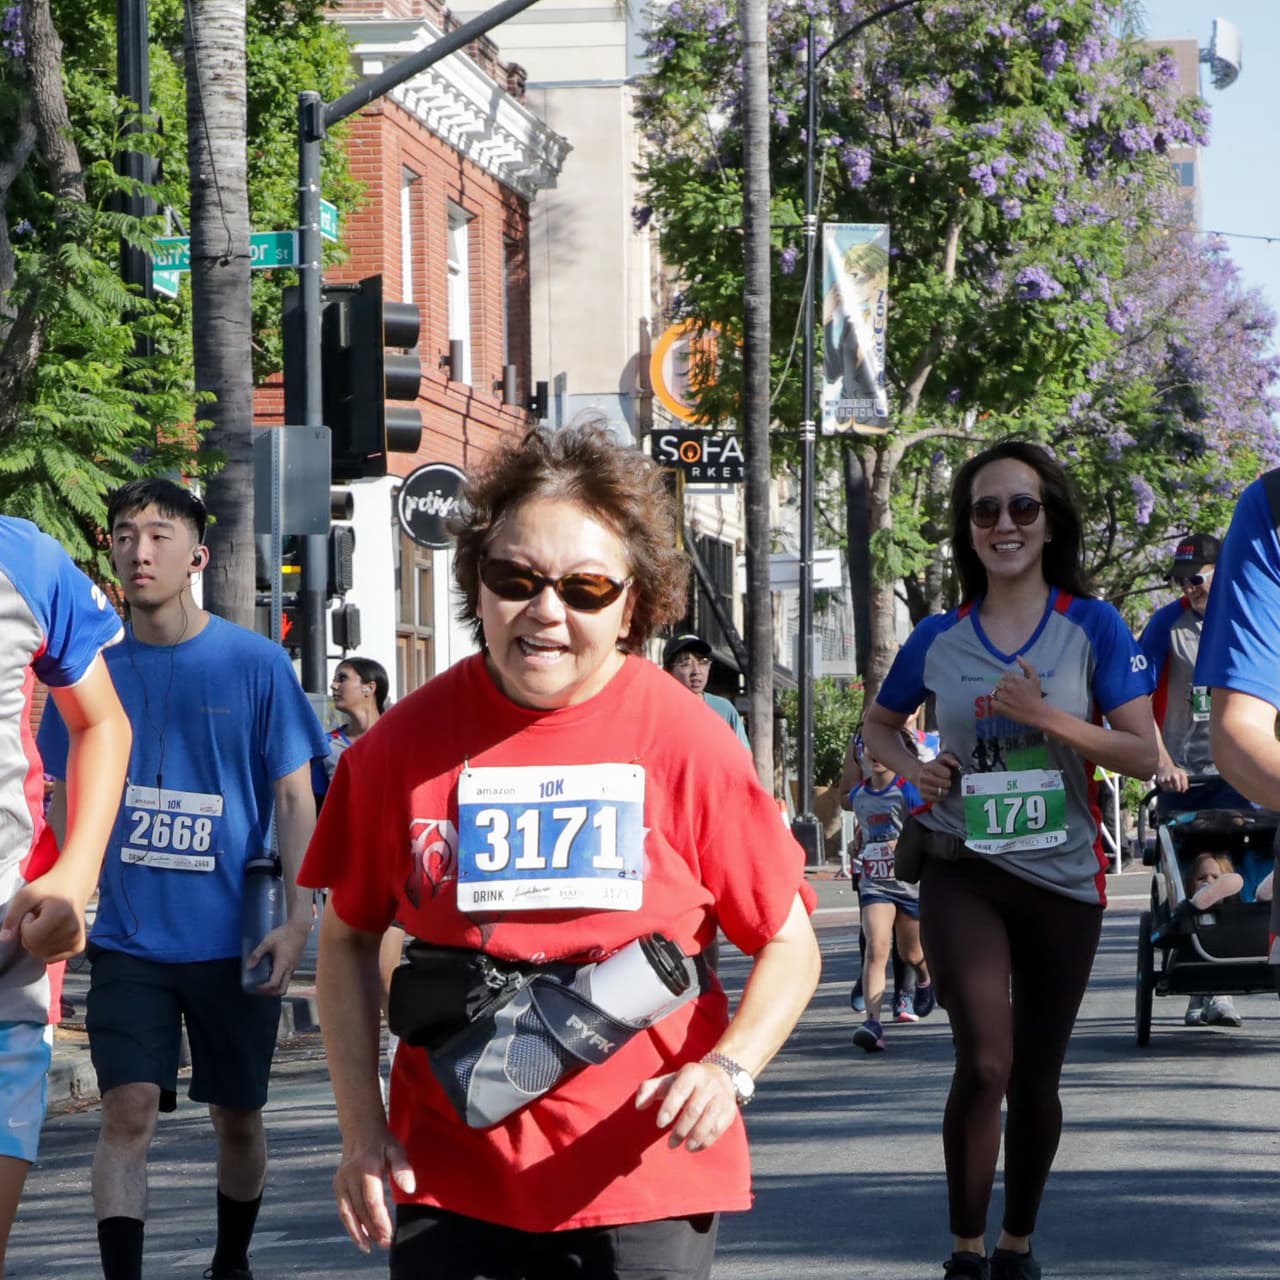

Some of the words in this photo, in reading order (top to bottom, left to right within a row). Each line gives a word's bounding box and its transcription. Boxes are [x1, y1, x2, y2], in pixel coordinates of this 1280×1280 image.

[275, 246, 288, 259] St
[691, 466, 744, 477] RKET
[476, 788, 516, 796] amazon
[539, 779, 564, 798] 10K
[1007, 779, 1018, 791] 5K
[167, 800, 182, 809] 10K
[984, 796, 1046, 834] 179
[130, 811, 212, 852] 2668
[475, 806, 624, 871] 3171
[473, 891, 504, 903] DRINK
